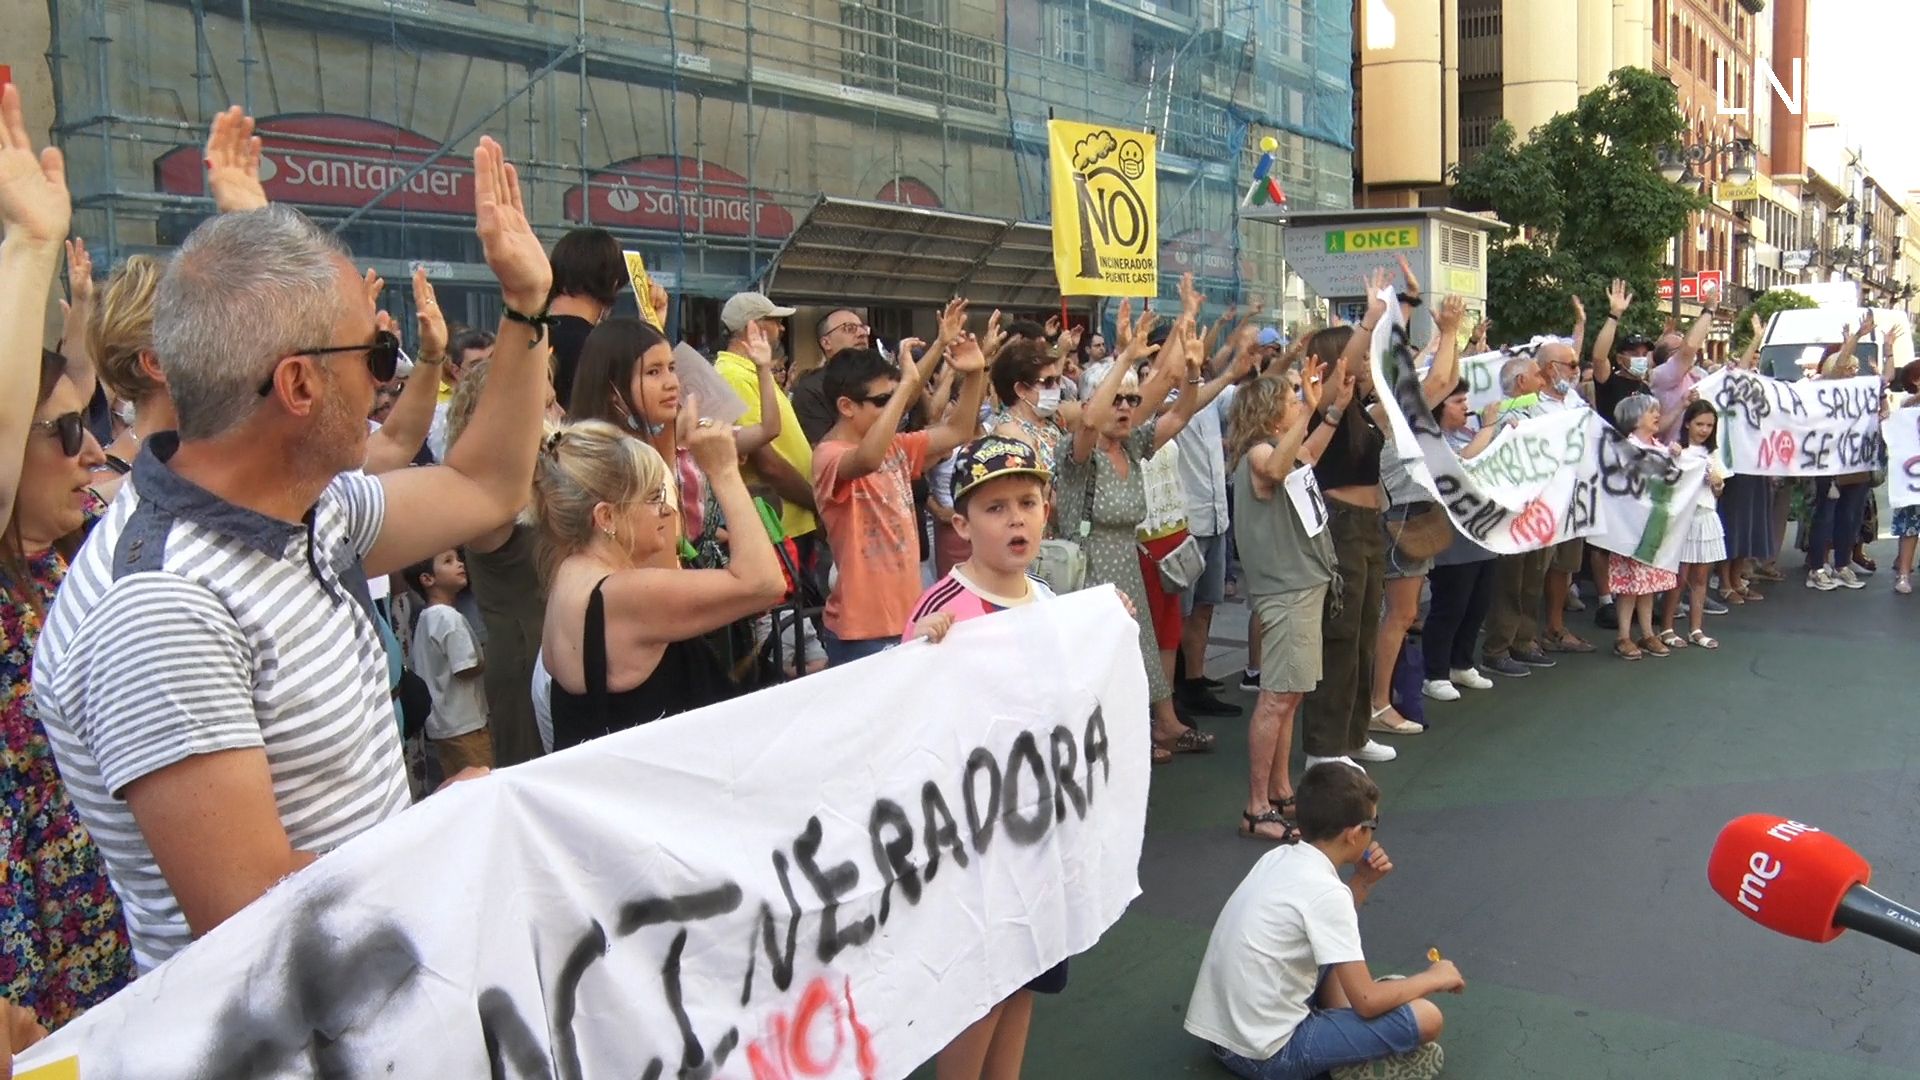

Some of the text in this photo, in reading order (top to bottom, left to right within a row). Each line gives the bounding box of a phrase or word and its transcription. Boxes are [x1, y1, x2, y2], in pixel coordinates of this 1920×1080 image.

[285, 154, 463, 197] Santander
[1352, 230, 1410, 248] ONCE
[1105, 272, 1131, 283] PUENTE
[1771, 381, 1808, 418] LA
[1801, 430, 1833, 469] SE
[1435, 474, 1507, 541] PERO
[1737, 851, 1781, 912] rne
